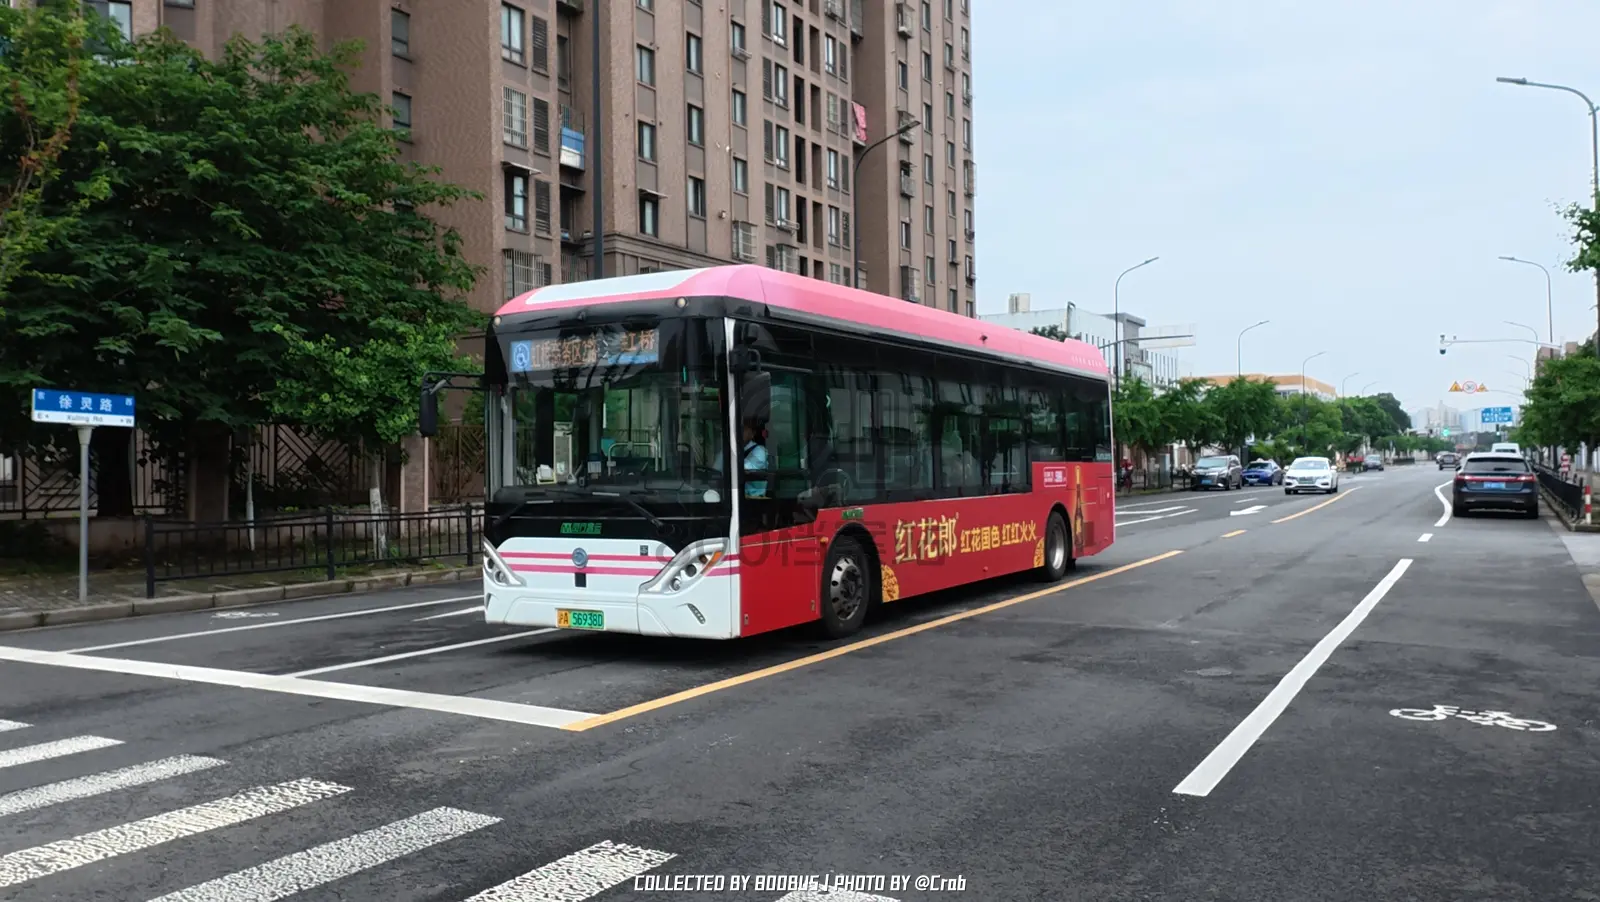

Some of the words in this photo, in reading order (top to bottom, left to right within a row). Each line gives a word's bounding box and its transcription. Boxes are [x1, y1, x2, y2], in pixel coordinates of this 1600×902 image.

[59, 394, 112, 412] 徐灵路
[895, 514, 958, 565] 红花郎
[960, 525, 1001, 554] 红花国色
[1001, 519, 1037, 546] 红红火火
